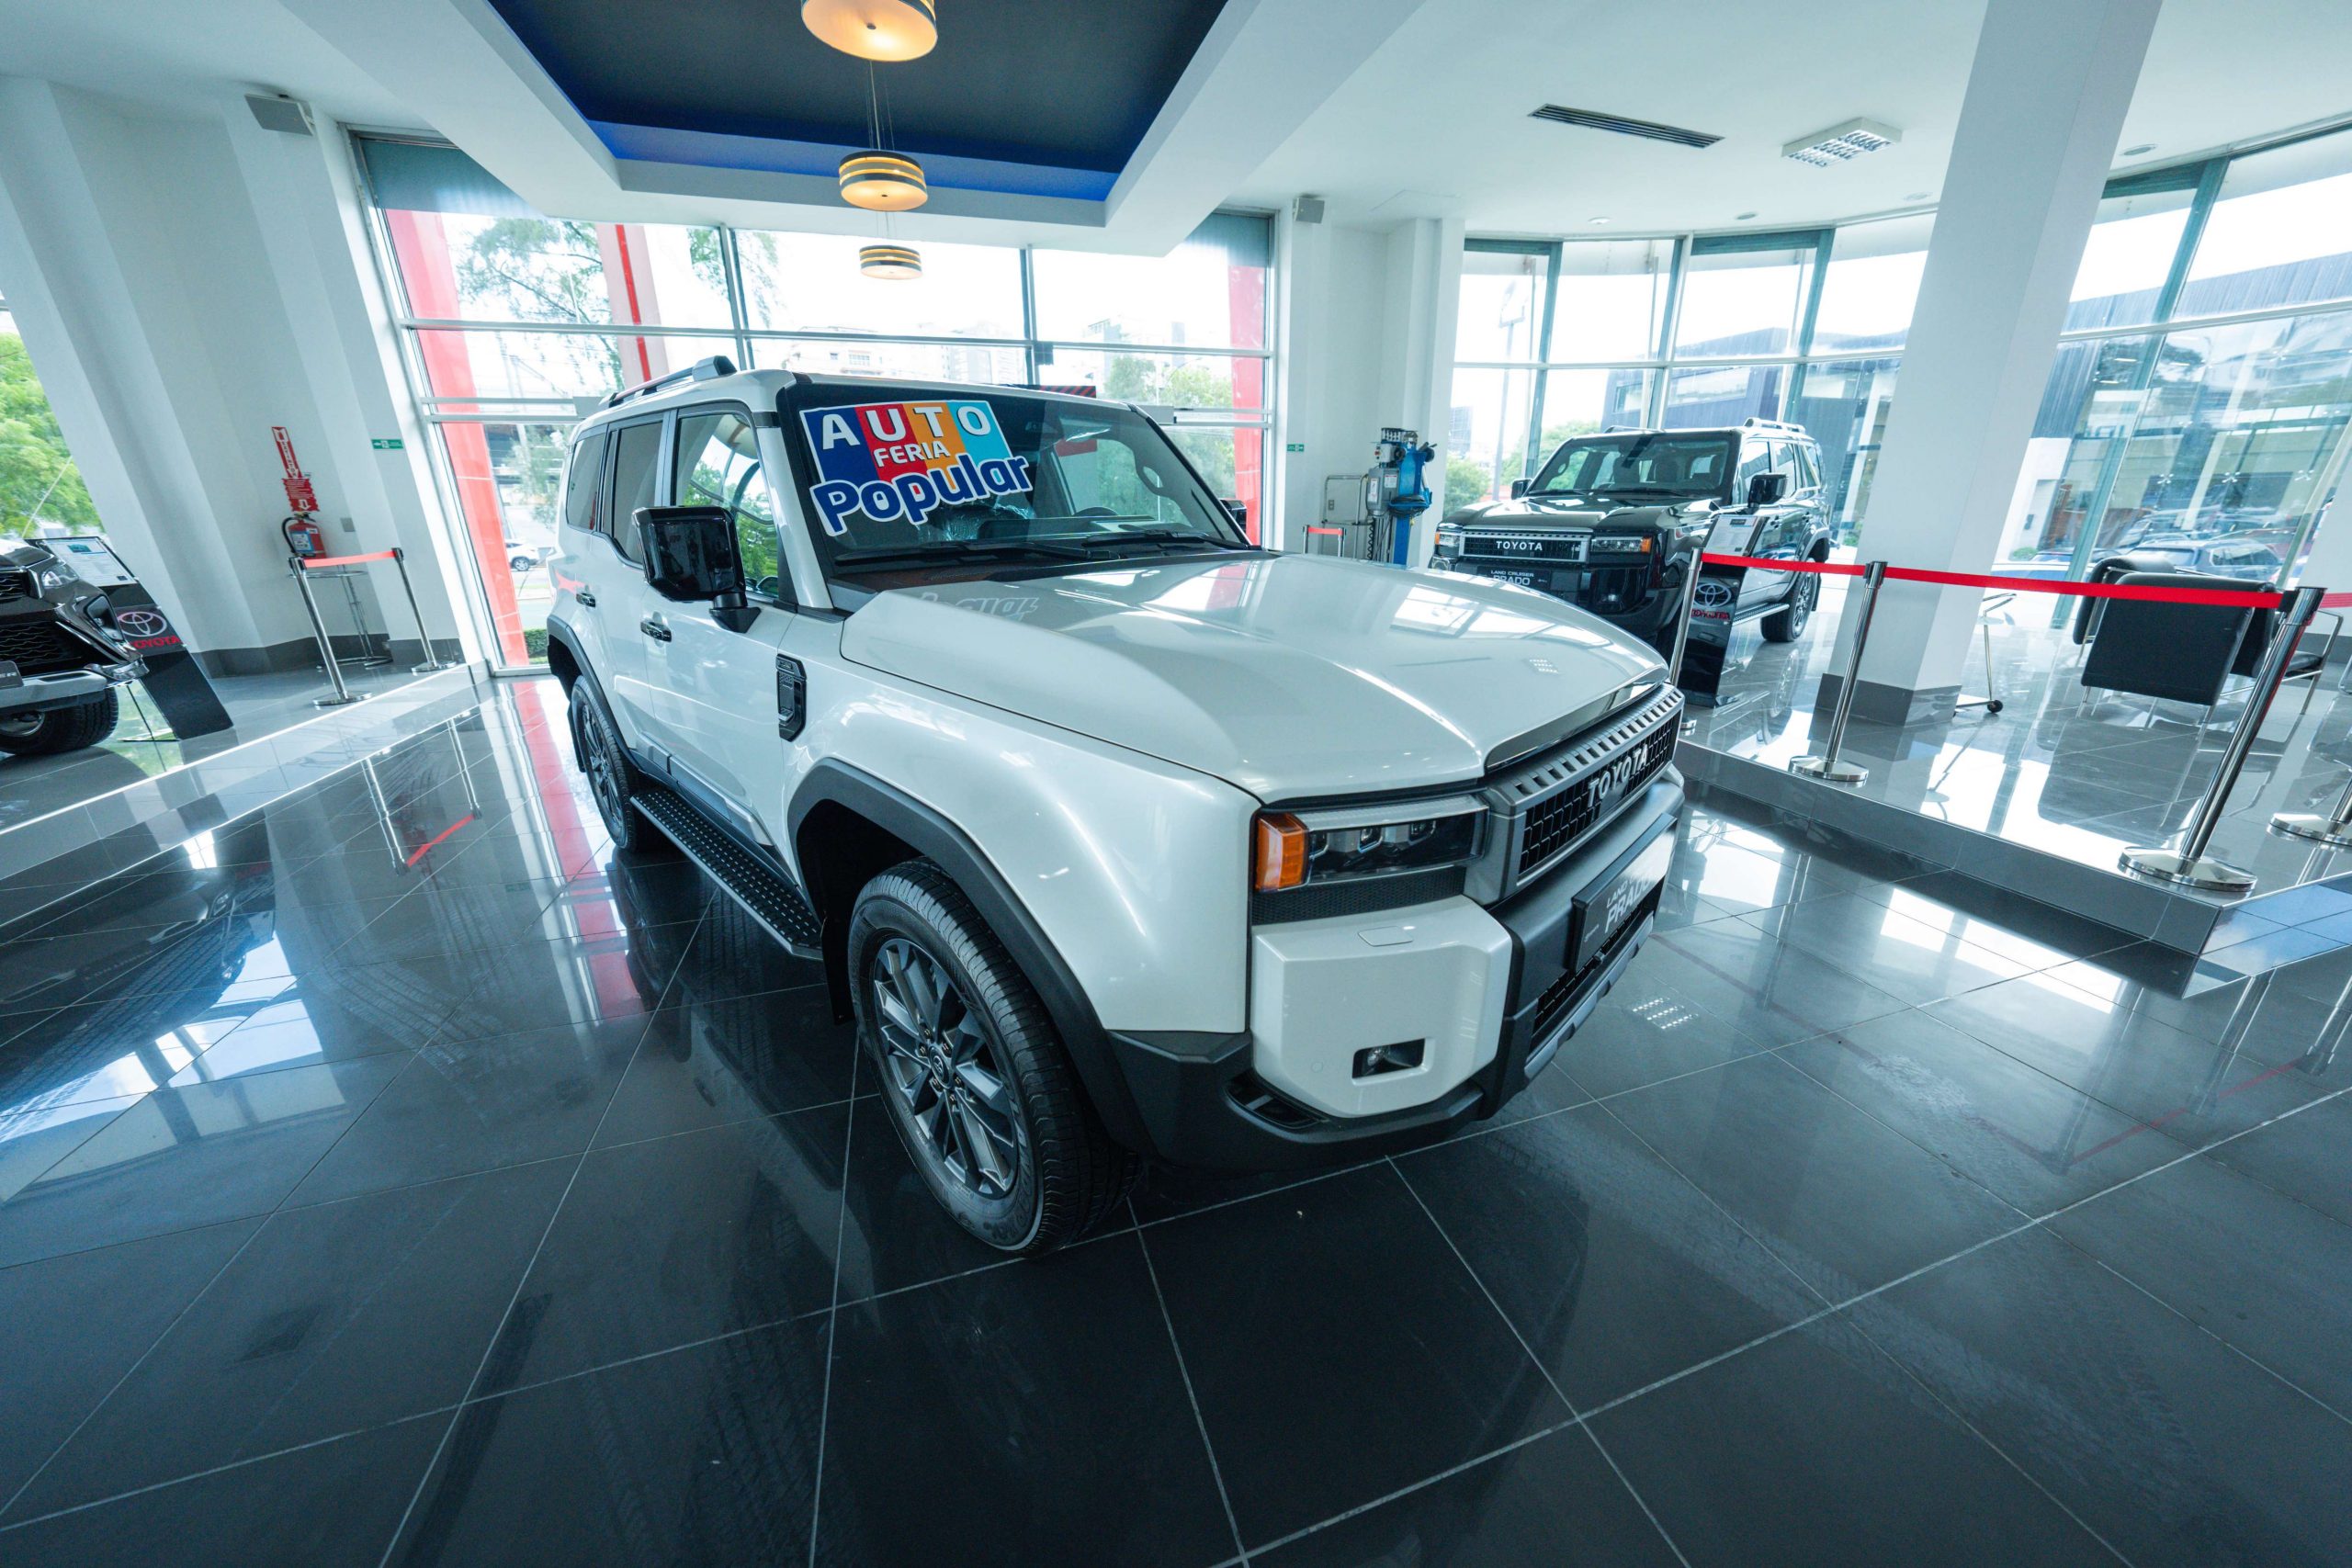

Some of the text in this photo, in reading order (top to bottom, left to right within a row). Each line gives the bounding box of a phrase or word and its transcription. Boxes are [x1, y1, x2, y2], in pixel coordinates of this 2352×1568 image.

[822, 405, 992, 450] AUTO
[873, 440, 951, 468] FERIA
[809, 453, 1033, 536] Popular
[1496, 540, 1543, 551] TOYOTA
[130, 636, 183, 649] OYOTA
[1588, 744, 1648, 807] TOYOTA
[1606, 880, 1628, 908] LAND
